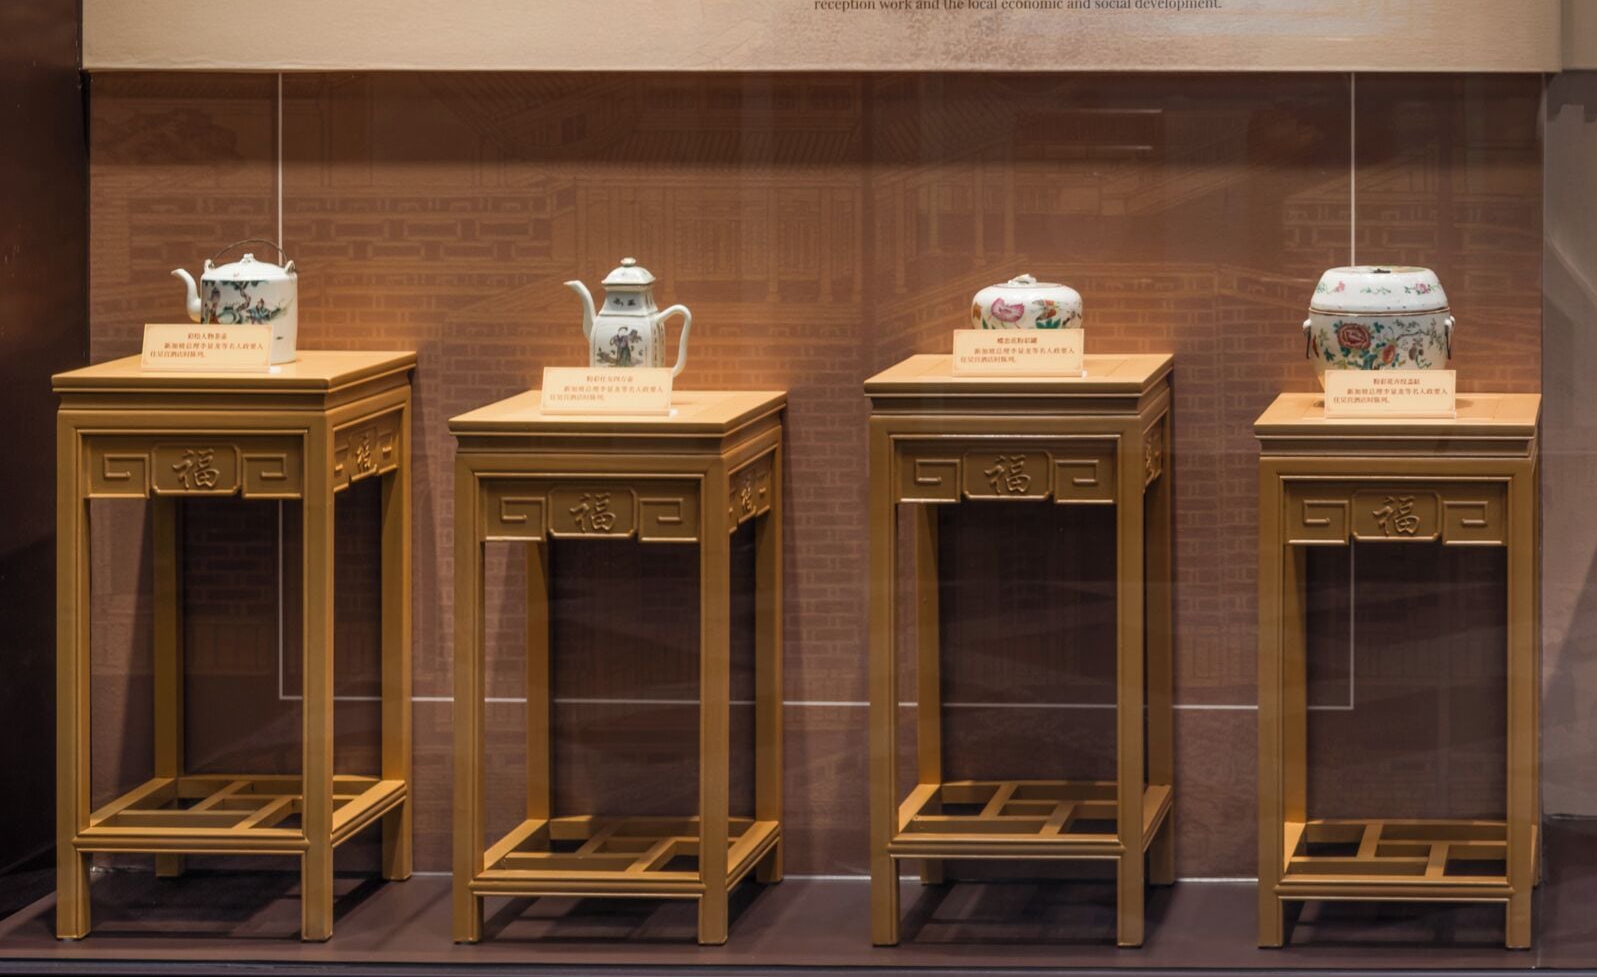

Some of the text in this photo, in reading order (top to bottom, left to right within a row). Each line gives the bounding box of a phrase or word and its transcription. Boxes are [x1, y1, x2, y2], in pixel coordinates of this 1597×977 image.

[172, 450, 220, 490] 福
[984, 454, 1033, 495] 福
[569, 492, 617, 534] 福
[1373, 496, 1421, 537] 福
